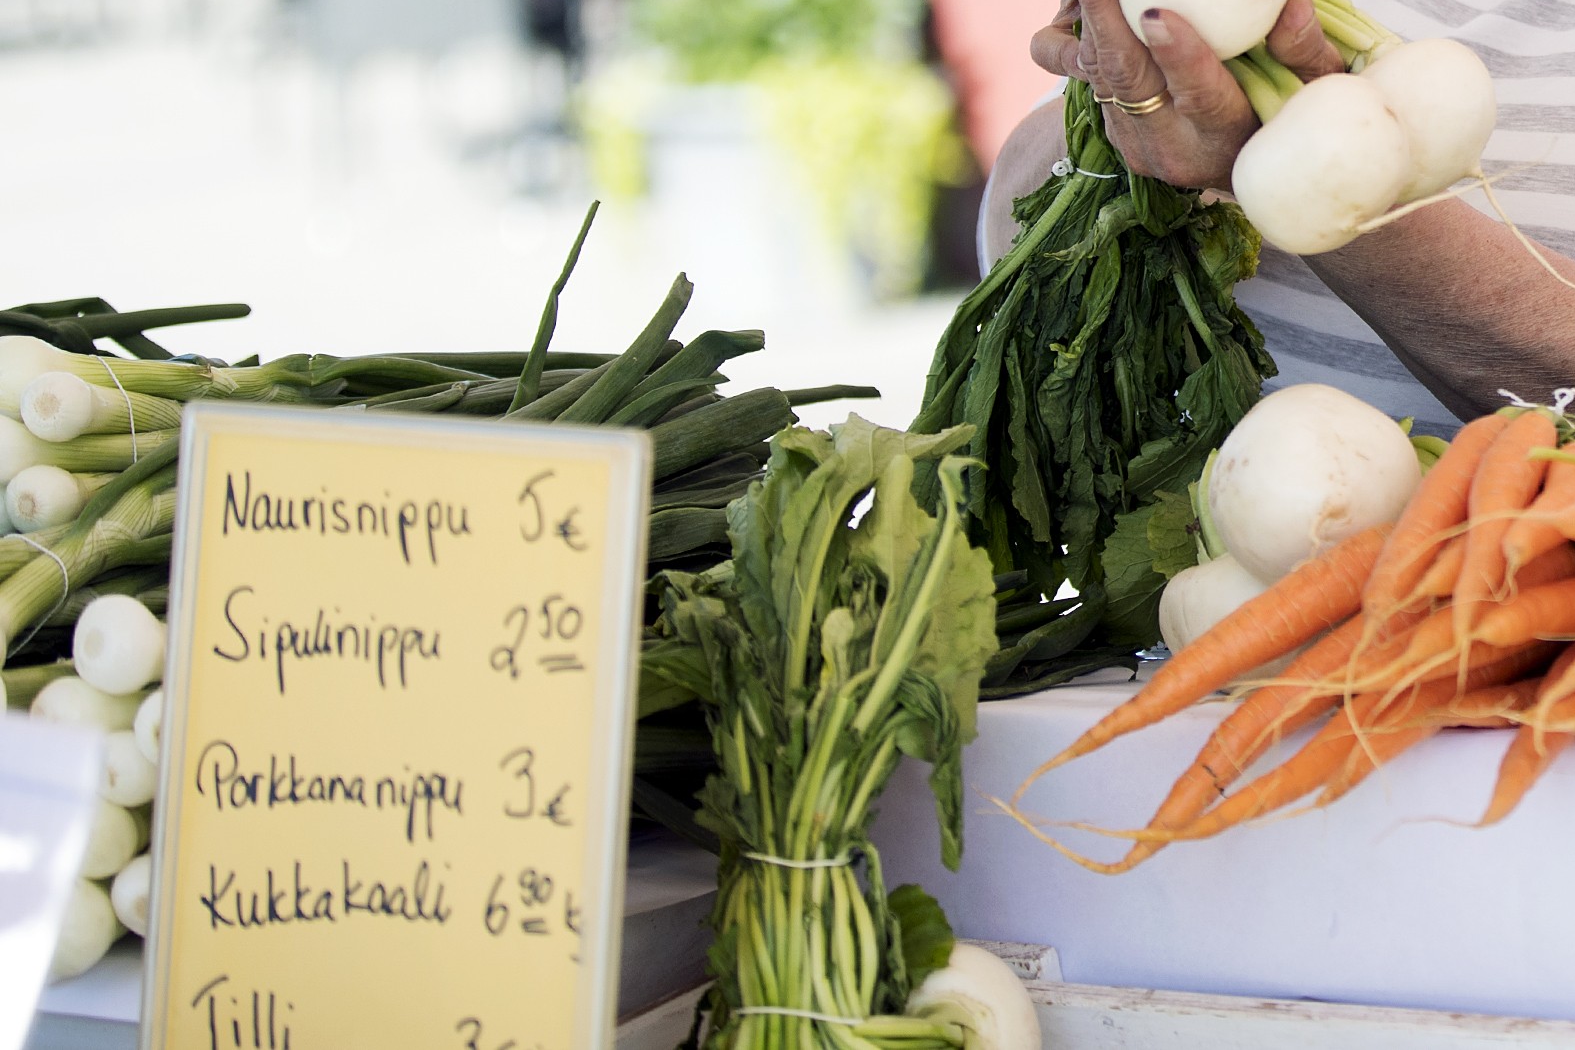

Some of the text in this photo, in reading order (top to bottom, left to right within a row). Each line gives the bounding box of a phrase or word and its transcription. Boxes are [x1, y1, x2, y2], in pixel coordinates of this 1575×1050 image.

[222, 469, 589, 565] Naurisnippu 5€
[213, 585, 441, 695] Sipulinippu
[195, 740, 573, 844] Porkkananippu 3€
[200, 860, 453, 930] Kukkakaali
[192, 974, 296, 1050] Tilli
